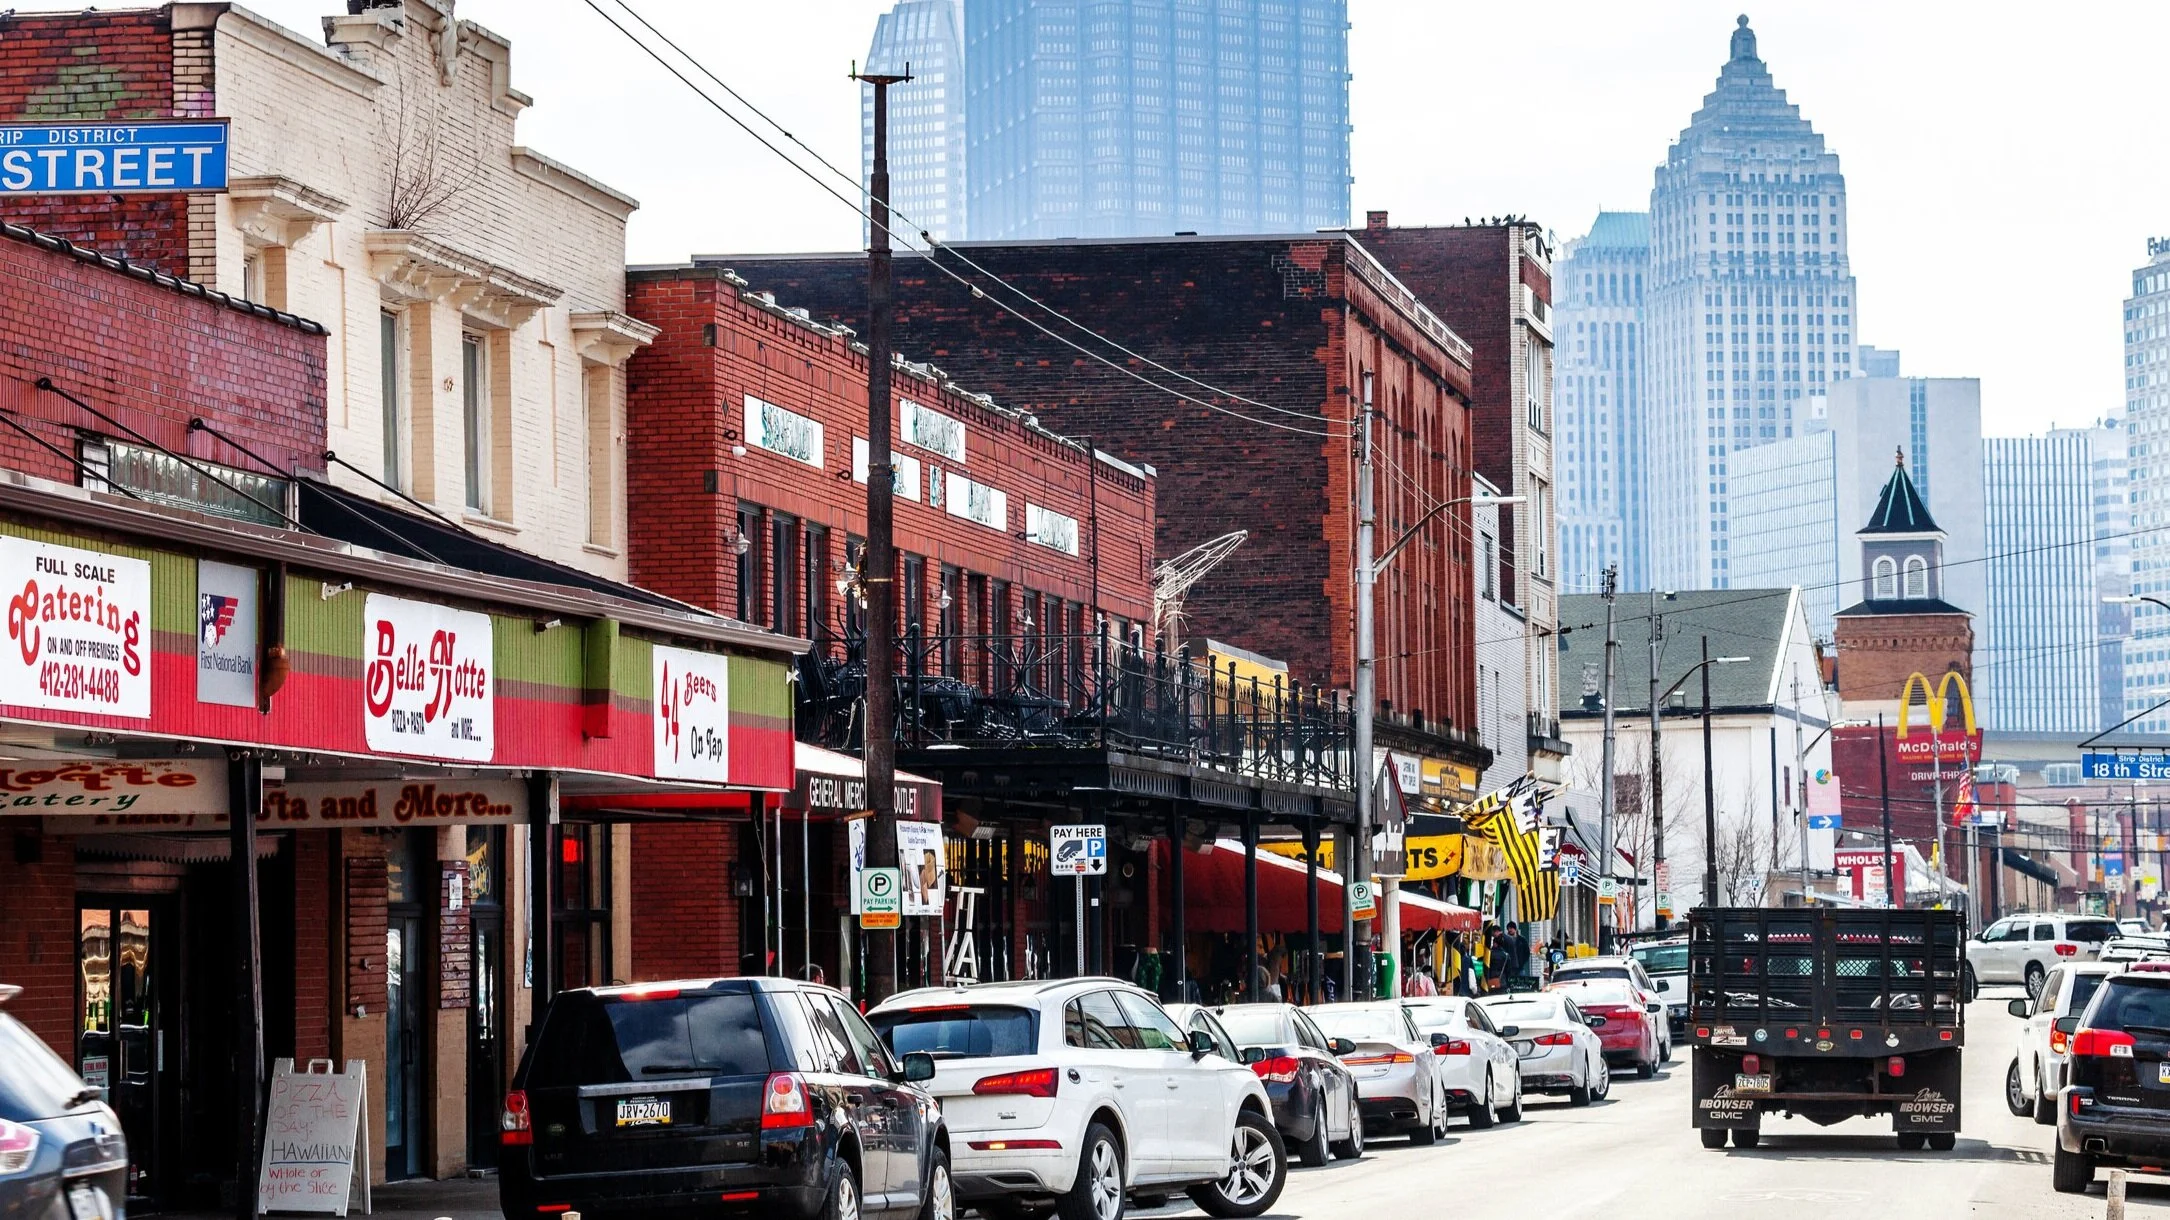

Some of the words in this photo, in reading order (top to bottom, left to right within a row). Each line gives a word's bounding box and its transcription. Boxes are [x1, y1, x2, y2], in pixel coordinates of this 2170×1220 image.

[49, 128, 138, 143] DISTRICT
[2, 147, 213, 190] STREET
[36, 556, 68, 576] FULL
[74, 562, 115, 584] SCALE
[8, 579, 141, 677] Catering
[47, 636, 57, 654] ON
[59, 638, 73, 656] AND
[75, 640, 87, 657] OFF
[88, 641, 120, 662] PREMISES
[201, 651, 212, 670] First
[213, 652, 237, 673] National
[237, 655, 253, 675] Bank
[366, 620, 425, 718] Bella
[425, 629, 486, 723] Notte
[40, 660, 119, 704] 412-281-4488
[684, 671, 717, 707] Beers
[392, 709, 406, 733] PIZZA
[410, 711, 425, 735] PASTA
[661, 659, 680, 765] 44
[451, 717, 459, 739] and
[691, 726, 704, 760] On
[706, 727, 723, 763] Tap
[1898, 741, 1977, 753] McDonald's
[2118, 755, 2136, 764] Strip
[2138, 755, 2165, 763] District
[2092, 763, 2110, 777] 18
[2114, 763, 2131, 777] th
[320, 788, 378, 820] and
[394, 783, 513, 823] More...
[809, 776, 842, 809] GENERAL
[844, 781, 865, 811] MERC
[893, 786, 917, 815] OUTLET
[1054, 828, 1073, 838] PAY
[1076, 827, 1102, 838] HERE
[1091, 840, 1102, 856] P
[1569, 868, 1577, 876] P
[875, 877, 886, 891] P
[275, 1080, 348, 1102] PIZZA
[309, 1103, 349, 1120] THE
[1704, 1100, 1754, 1110] BOWSER
[1710, 1111, 1743, 1119] GMC
[1905, 1103, 1955, 1113] BOWSER
[1910, 1115, 1943, 1123] GMC
[310, 1169, 329, 1178] or
[260, 1182, 275, 1200] by
[279, 1181, 301, 1194] the
[307, 1181, 338, 1195] Slice
